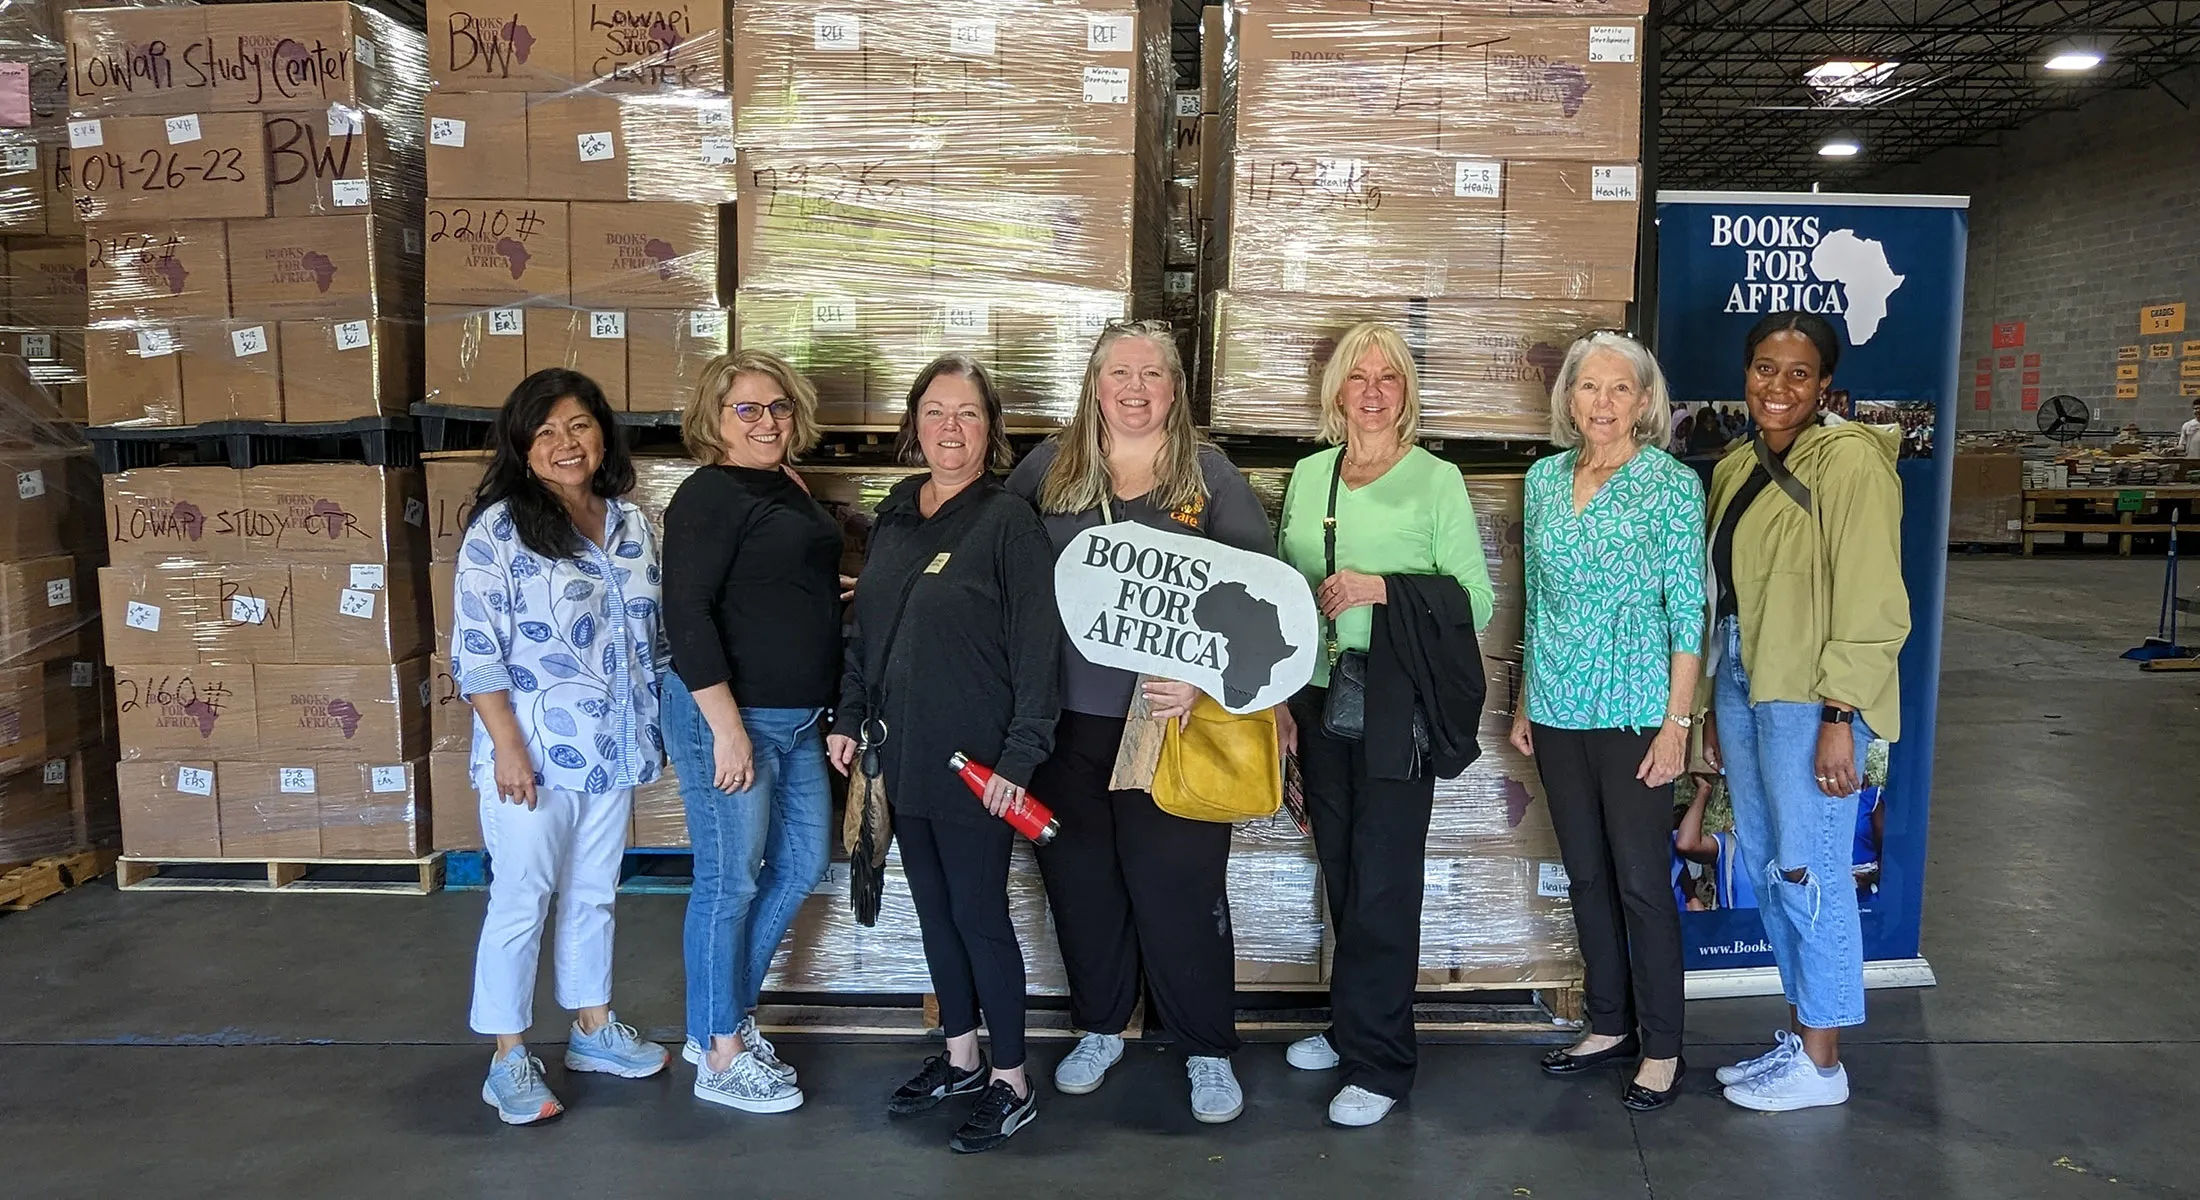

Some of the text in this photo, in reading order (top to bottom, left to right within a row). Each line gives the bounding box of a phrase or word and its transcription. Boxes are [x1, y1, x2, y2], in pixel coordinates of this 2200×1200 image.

[1093, 25, 1117, 43] REF
[449, 11, 518, 79] BW
[1291, 51, 1345, 64] BOOKS
[1493, 55, 1547, 69] BOOKS
[1503, 87, 1561, 102] AFRICA
[264, 117, 354, 185] BW
[82, 149, 245, 191] 04-26-23
[1463, 169, 1490, 182] 5-8
[1595, 169, 1611, 177] 5-8
[1595, 187, 1632, 197] Health
[460, 231, 499, 243] BOOKS
[1710, 215, 1820, 248] BOOKS
[606, 233, 647, 245] BOOKS
[265, 247, 303, 259] BOOKS
[472, 244, 495, 255] FOR
[619, 246, 643, 257] FOR
[277, 260, 300, 271] FOR
[464, 256, 509, 268] AFRICA
[612, 259, 658, 270] AFRICA
[1744, 250, 1807, 281] FOR
[271, 271, 316, 283] AFRICA
[1723, 284, 1844, 314] AFRICA
[495, 321, 517, 332] ERS
[597, 325, 619, 335] ERS
[1478, 335, 1531, 349] BOOKS
[1494, 352, 1523, 366] FOR
[1482, 368, 1543, 382] AFRICA
[277, 494, 315, 505] BOOKS
[289, 506, 312, 517] FOR
[1170, 511, 1198, 528] care
[216, 508, 289, 548] STUDY
[304, 511, 373, 539] CTR
[1082, 534, 1212, 591] BOOKS
[219, 578, 288, 630] BW
[1114, 579, 1191, 625] FOR
[1083, 611, 1222, 671] AFRICA
[291, 694, 330, 705] BOOKS
[161, 706, 184, 716] FOR
[303, 706, 327, 717] FOR
[156, 717, 199, 728] AFRICA
[297, 718, 342, 728] AFRICA
[183, 769, 199, 777] 5-8
[286, 769, 303, 777] 5-8
[185, 778, 205, 788] ERS
[285, 778, 307, 788] ERS
[1542, 880, 1569, 893] Healt
[1699, 939, 1774, 955] www.Books
